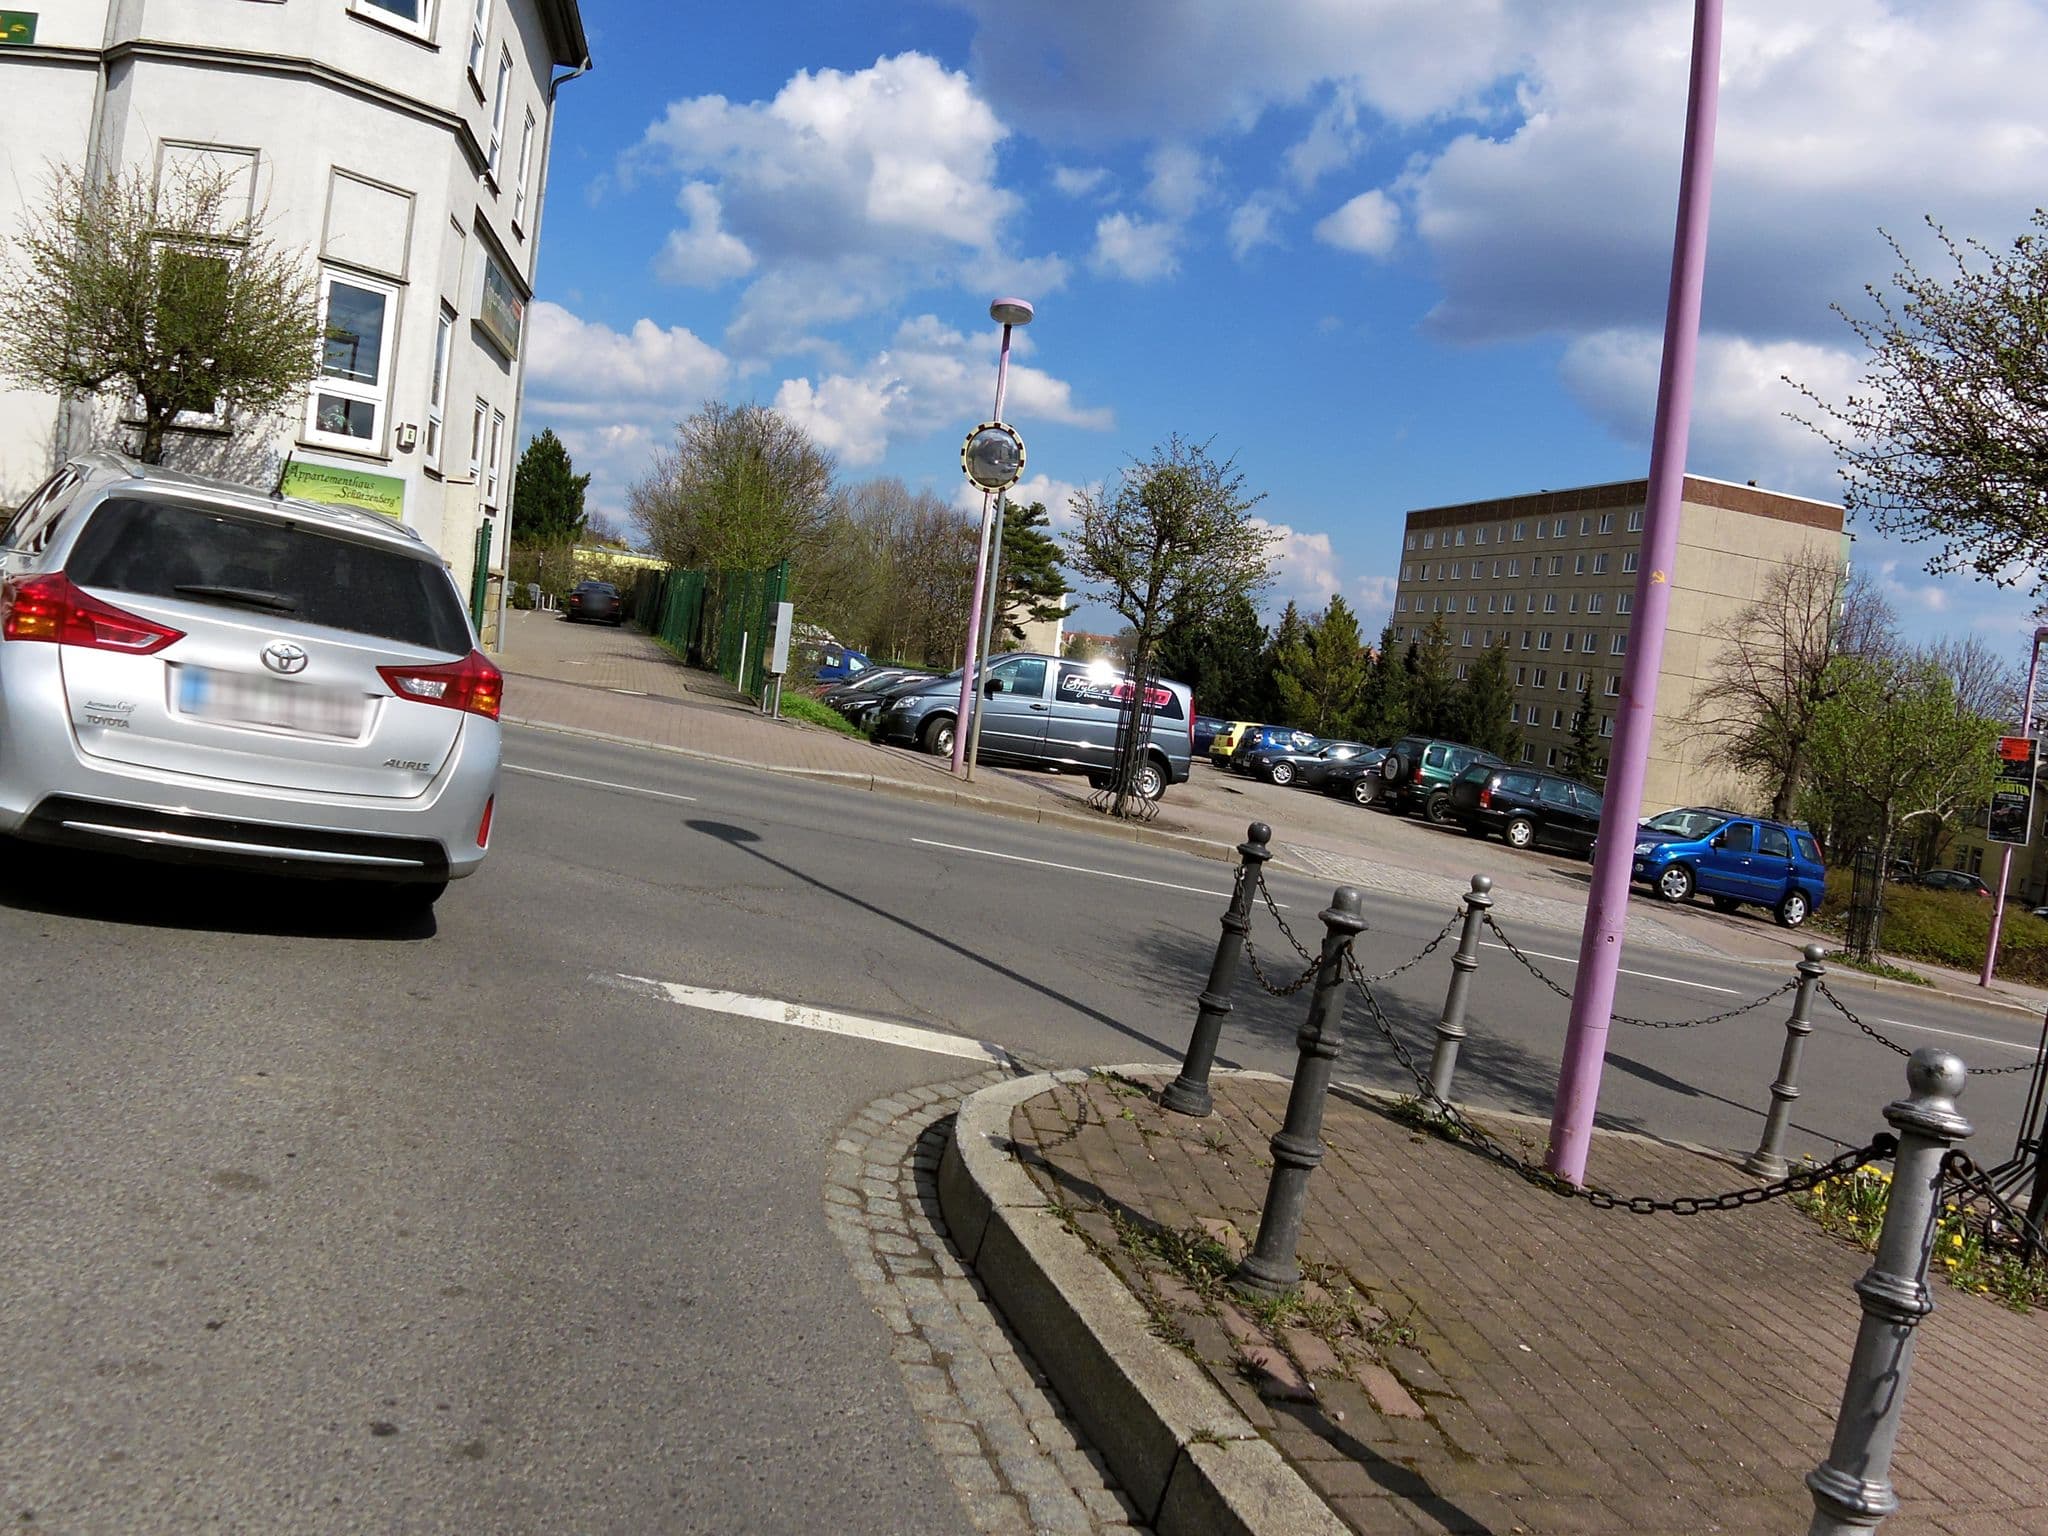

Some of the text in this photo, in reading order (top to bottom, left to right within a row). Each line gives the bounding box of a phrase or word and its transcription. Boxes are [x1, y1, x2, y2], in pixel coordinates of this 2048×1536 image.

[290, 465, 375, 489] Appartementhaus
[86, 715, 130, 728] TOYOTA
[383, 759, 430, 771] AURIS
